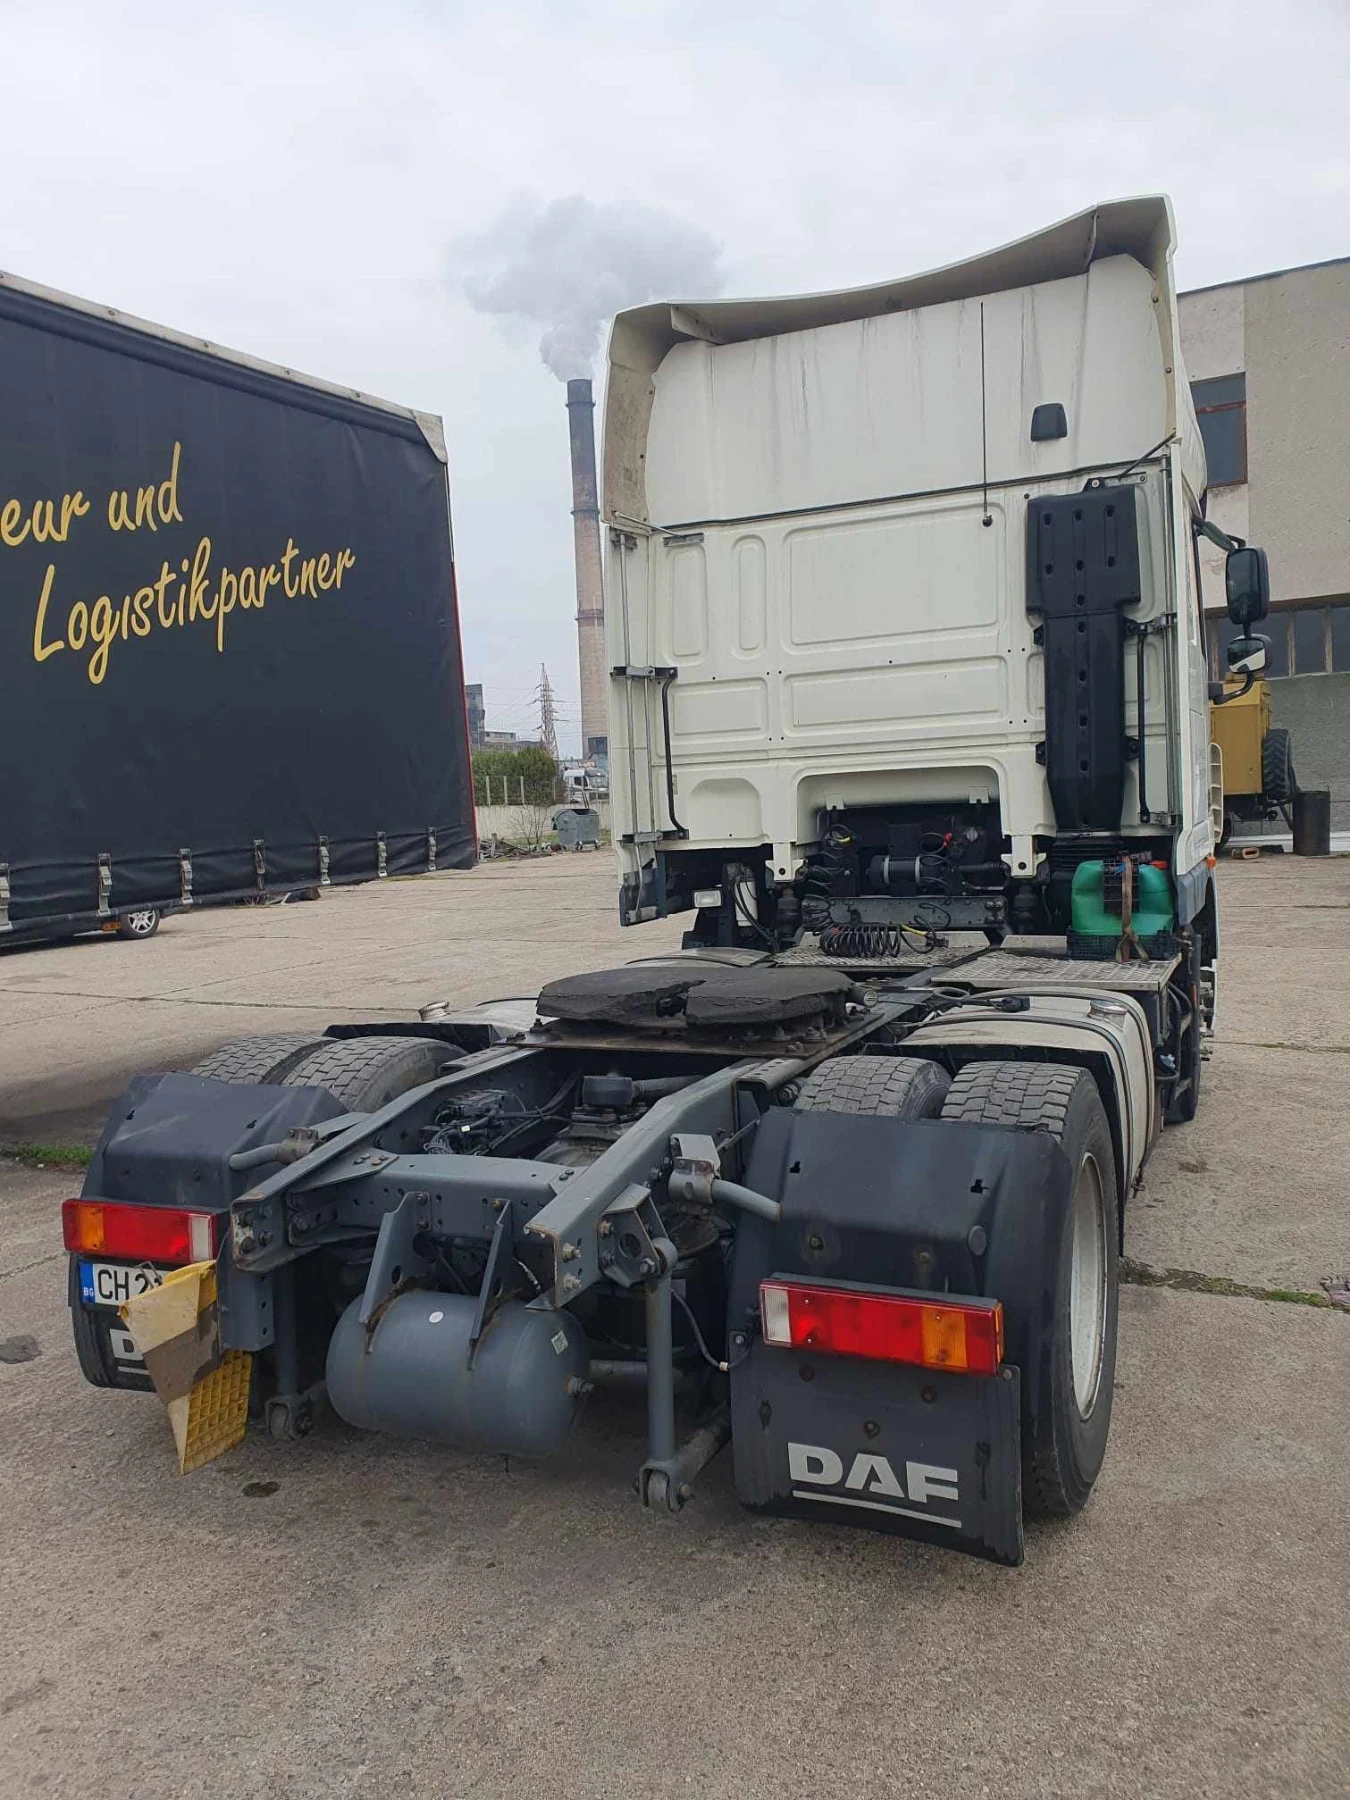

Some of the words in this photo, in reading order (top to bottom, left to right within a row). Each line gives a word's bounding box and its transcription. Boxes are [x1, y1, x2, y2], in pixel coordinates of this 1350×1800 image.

[0, 490, 91, 547] eur
[108, 440, 184, 532] und
[34, 536, 356, 685] Logistikpartner
[83, 1286, 94, 1297] BG
[98, 1268, 130, 1301] CH
[788, 1442, 959, 1504] DAF
